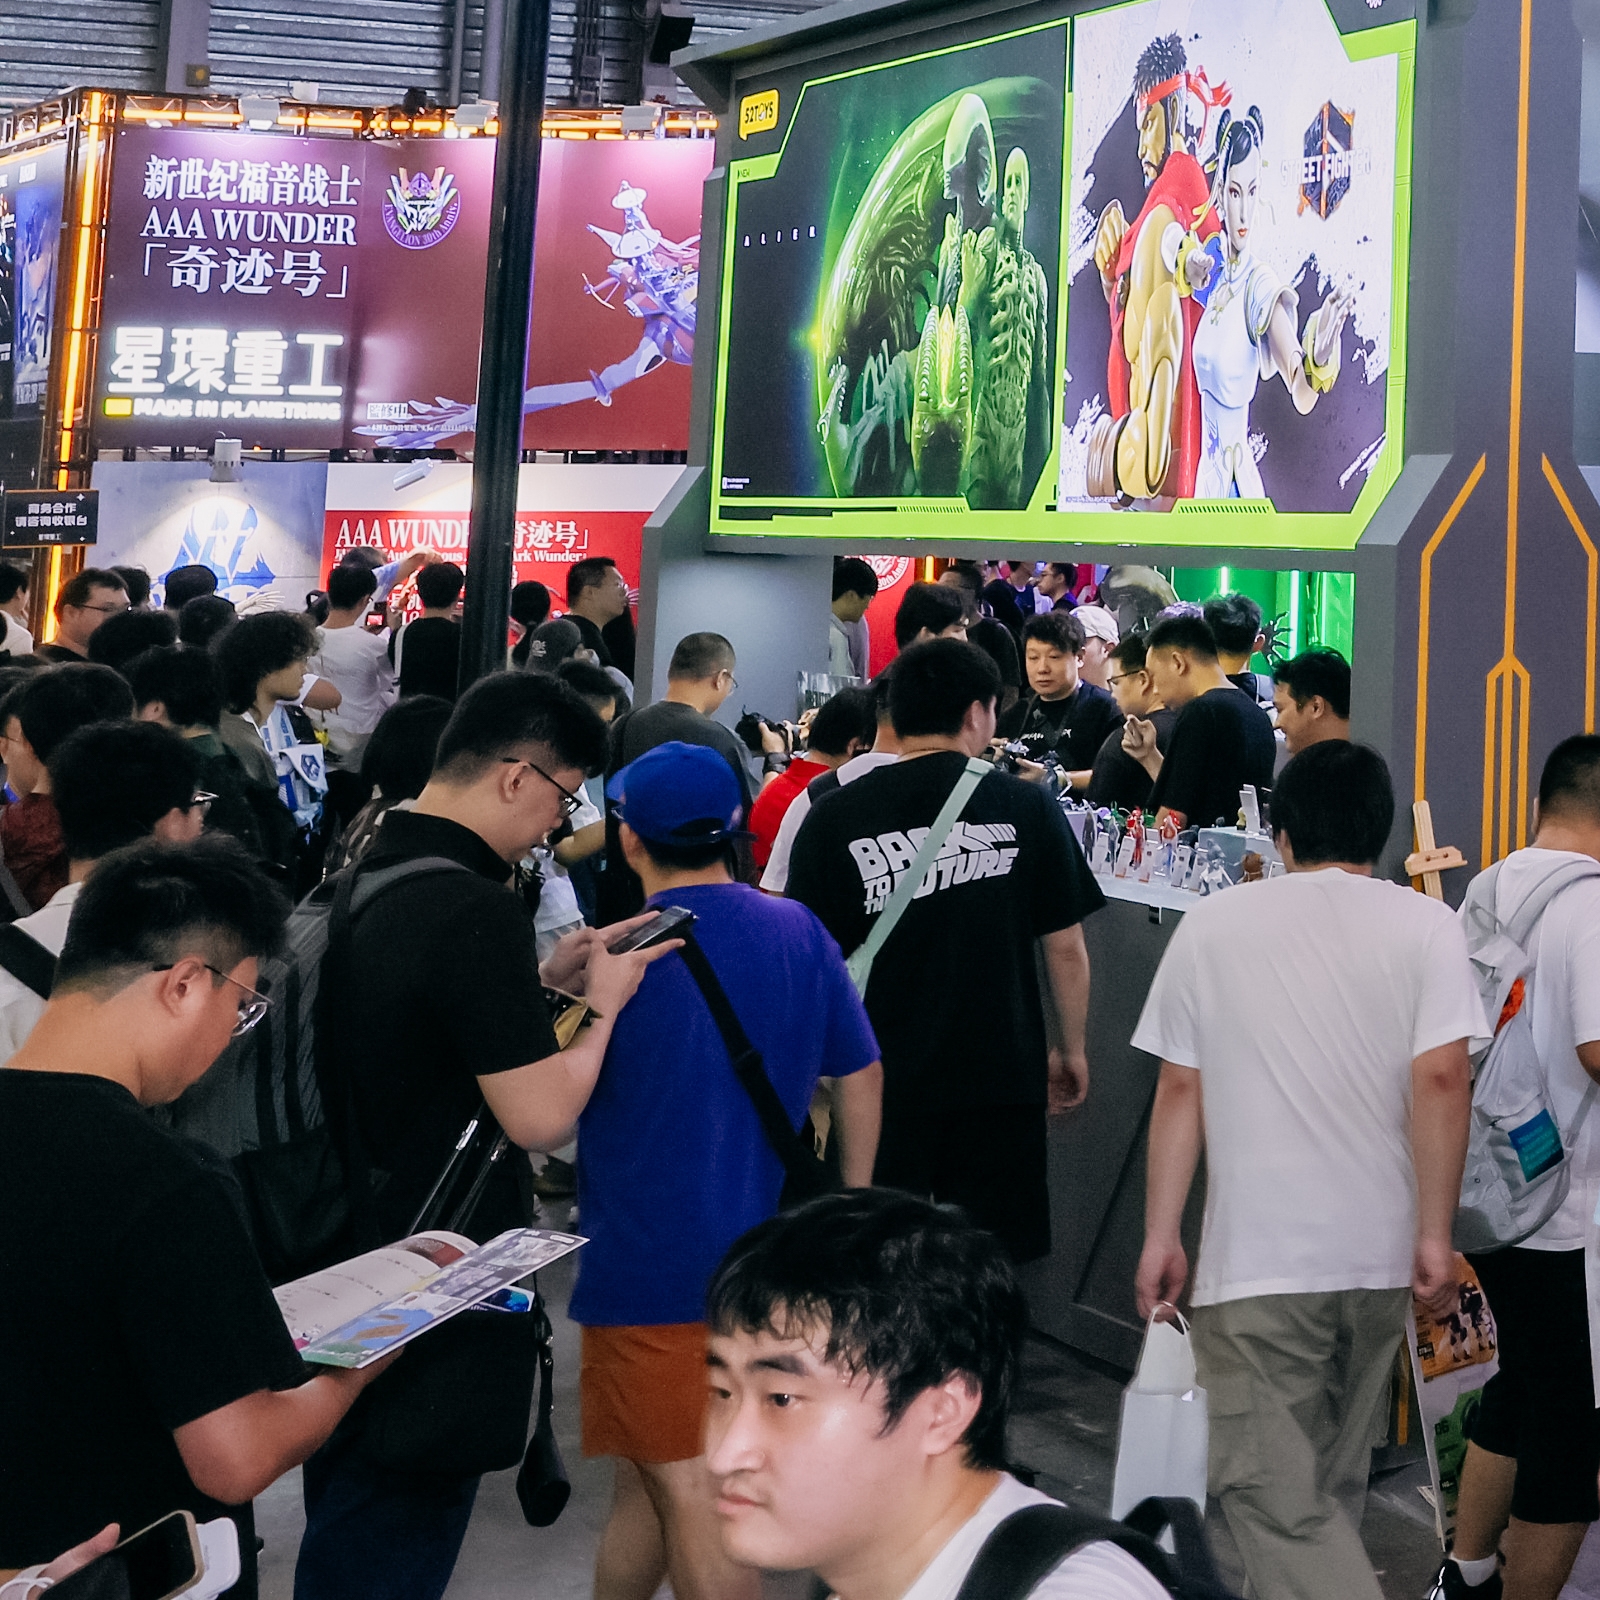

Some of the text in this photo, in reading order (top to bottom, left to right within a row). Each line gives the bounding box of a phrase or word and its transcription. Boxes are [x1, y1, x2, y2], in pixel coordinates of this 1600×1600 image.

[744, 101, 774, 124] 52TOYS
[143, 154, 361, 208] 新世纪福音战士
[1281, 155, 1322, 187] STREET
[140, 206, 357, 245] AAA WUNDER
[384, 203, 421, 246] EVANGELION
[422, 229, 442, 245] 30th
[143, 243, 347, 298] 「奇迹号」
[132, 398, 341, 420] MADE IN PLANETRING
[335, 519, 384, 548] AAA
[864, 875, 891, 900] TO
